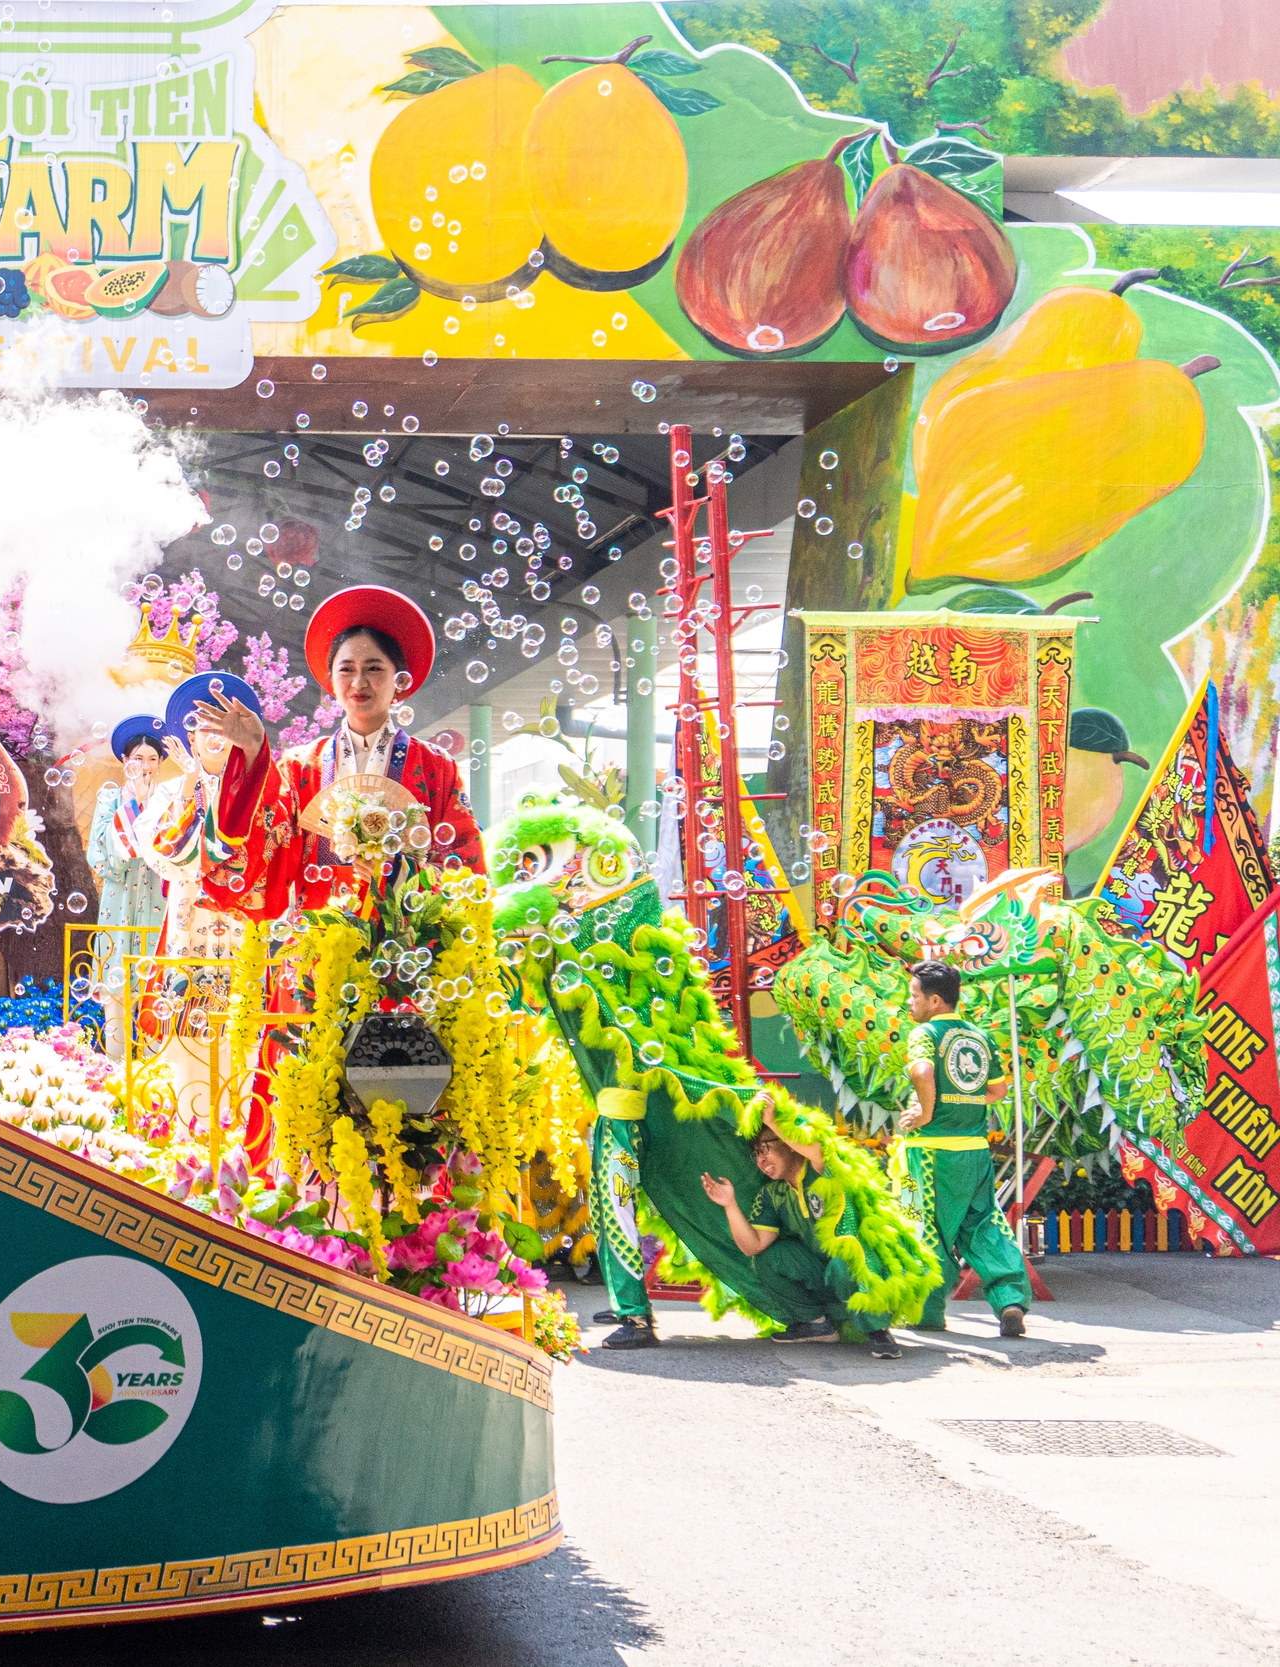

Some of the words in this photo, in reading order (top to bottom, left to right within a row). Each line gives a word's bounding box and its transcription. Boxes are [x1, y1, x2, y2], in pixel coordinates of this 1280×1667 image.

[90, 59, 230, 136] TIÊN
[904, 640, 978, 687] 越南
[1204, 1073, 1280, 1161] THIÊN
[1212, 1156, 1280, 1227] MÔN
[98, 1323, 116, 1335] SUOI
[117, 1318, 135, 1327] TIEN
[136, 1317, 162, 1327] THEME
[161, 1322, 179, 1337] PARK
[117, 1372, 184, 1387] YEARS
[118, 1389, 179, 1397] ANNIVERSARY
